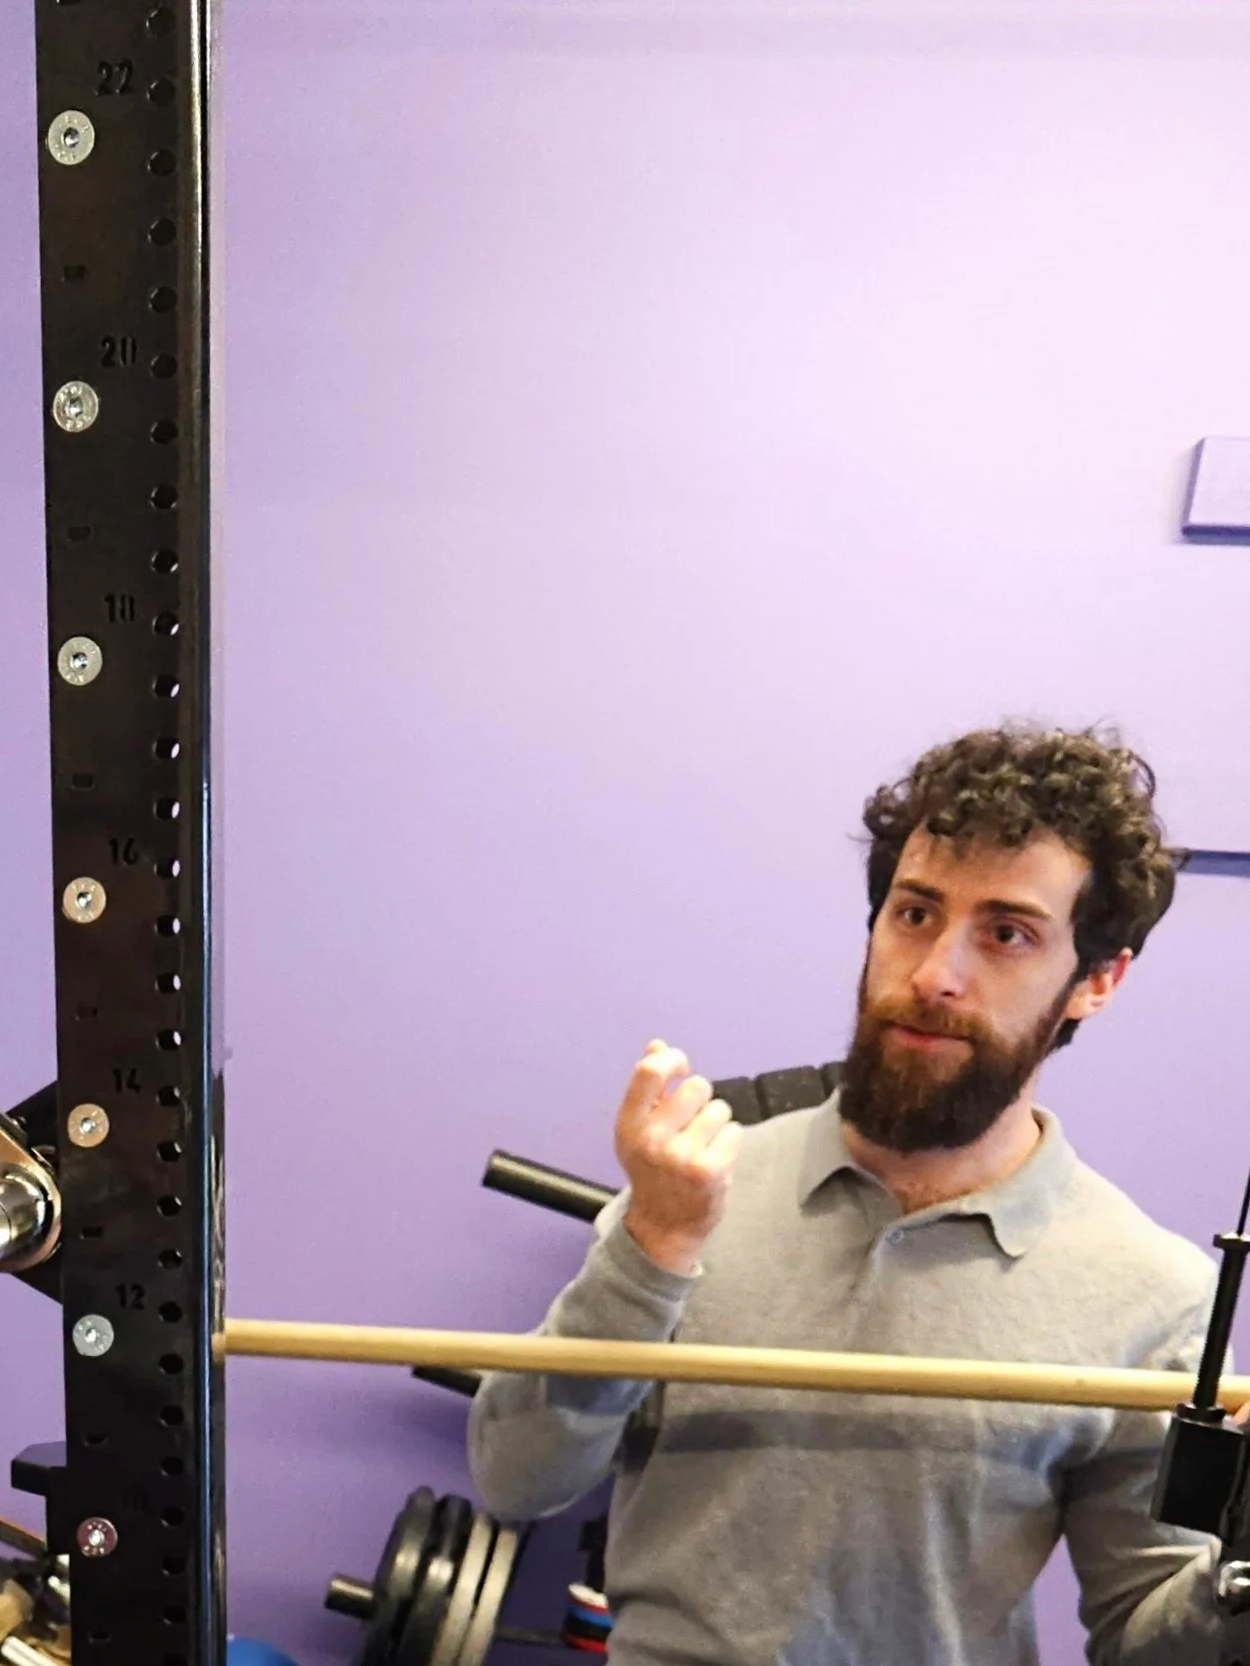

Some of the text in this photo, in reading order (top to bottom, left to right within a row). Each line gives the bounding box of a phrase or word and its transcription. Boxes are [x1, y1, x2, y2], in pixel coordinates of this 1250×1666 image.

[94, 59, 135, 96] 22
[108, 838, 139, 866] 16
[112, 1068, 142, 1093] 14
[115, 1285, 146, 1310] 12
